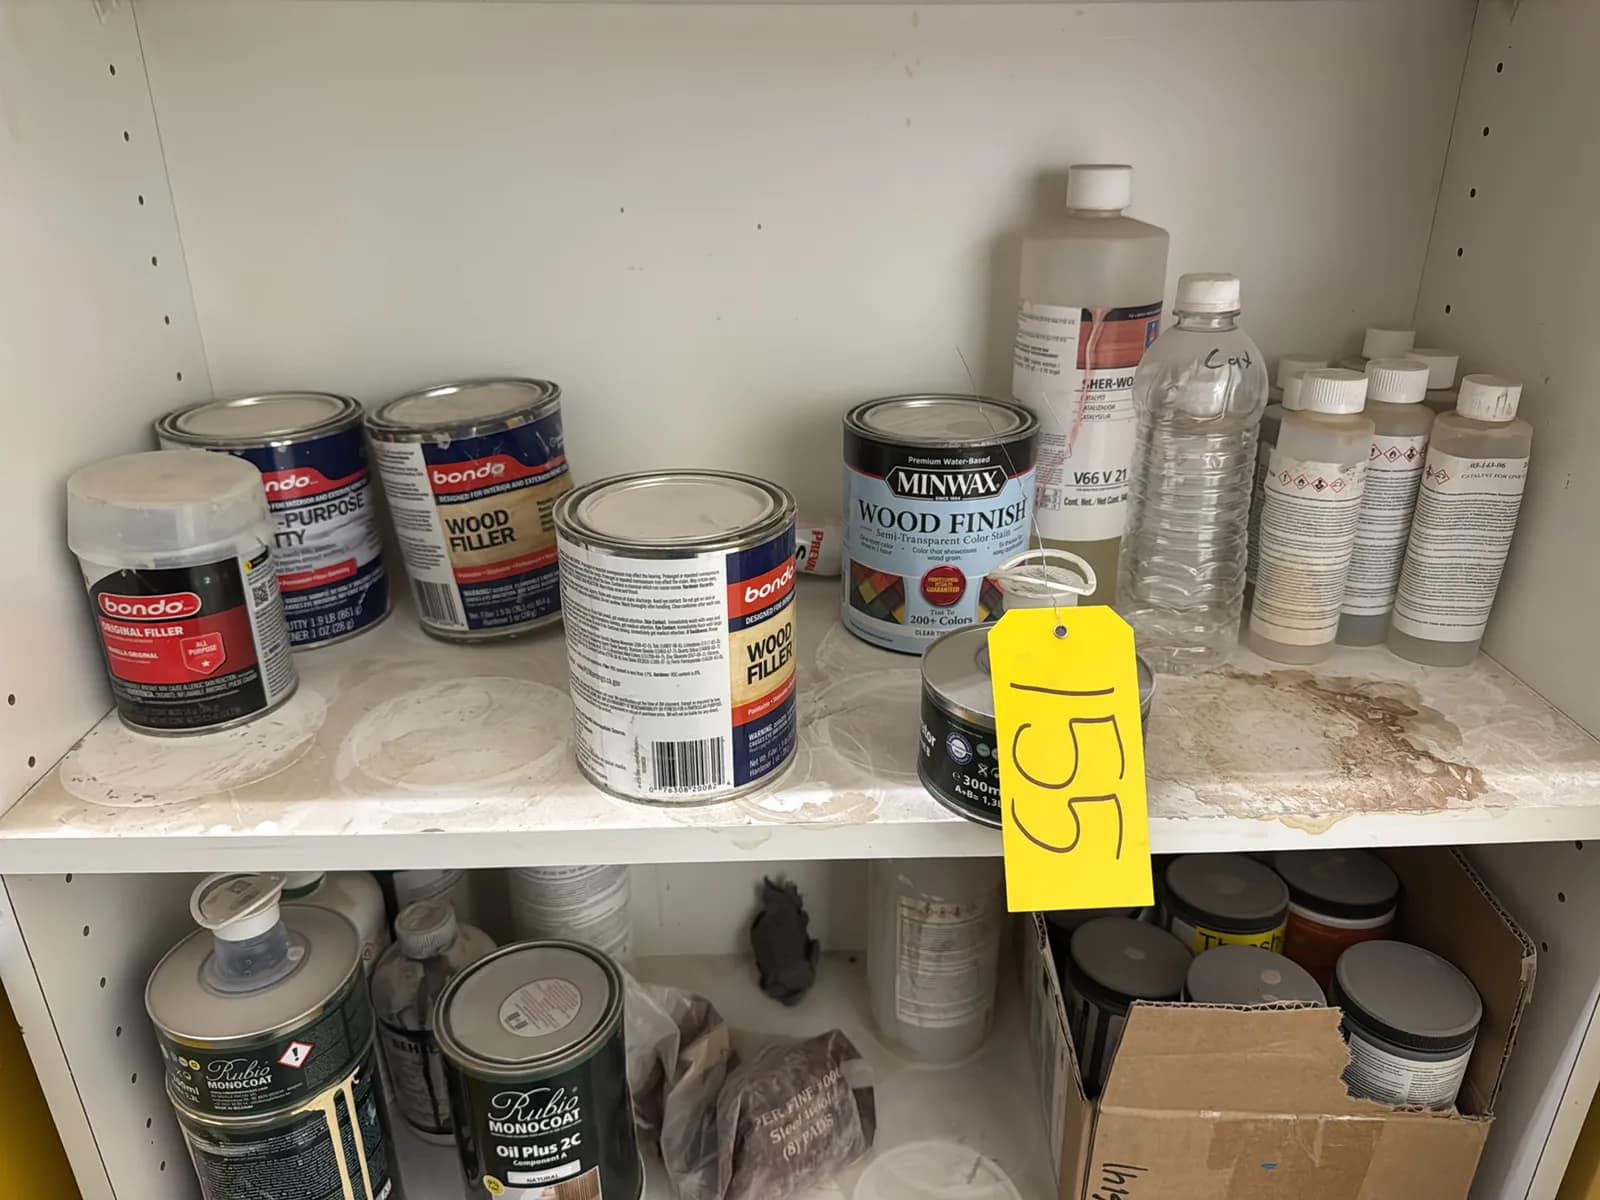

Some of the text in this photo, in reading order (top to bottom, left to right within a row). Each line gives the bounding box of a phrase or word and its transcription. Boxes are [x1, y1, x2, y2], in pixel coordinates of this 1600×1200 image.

[1082, 376, 1134, 390] SHER-WO
[907, 455, 991, 466] Premium Water-Based
[265, 473, 311, 492] ndo
[433, 462, 506, 485] bondo
[897, 470, 998, 496] MINWAX
[1073, 471, 1100, 485] V66
[1102, 470, 1113, 483] V
[278, 492, 365, 529] -PURPOSE
[445, 509, 509, 535] WOOD
[858, 498, 1028, 535] WOOD FINISH
[274, 529, 307, 549] TTY
[450, 527, 516, 552] FILLER
[875, 528, 960, 547] Semi-Transparent
[963, 534, 989, 546] Color
[990, 529, 1012, 542] Stain
[806, 529, 824, 571] PREV
[912, 546, 929, 554] Color
[930, 547, 943, 555] that
[744, 564, 795, 604] bondo
[104, 597, 181, 616] bondo
[144, 626, 185, 638] FILLER
[288, 619, 308, 631] UTTY
[324, 611, 337, 624] LB
[910, 615, 973, 626] 200+ Colors
[289, 630, 310, 642] ENER
[746, 622, 793, 663] WOOD
[747, 644, 793, 685] FILLER
[1010, 682, 1125, 861] 155
[962, 774, 1001, 796] 300m
[205, 1057, 271, 1082] Rubio
[206, 1074, 273, 1090] MONOCOAT
[487, 1086, 579, 1122] Rubio
[488, 1107, 582, 1135] MONOCOAT
[802, 1113, 835, 1146] PADS
[496, 1132, 582, 1159] Oil Plus 2C
[512, 1151, 568, 1167] Component A
